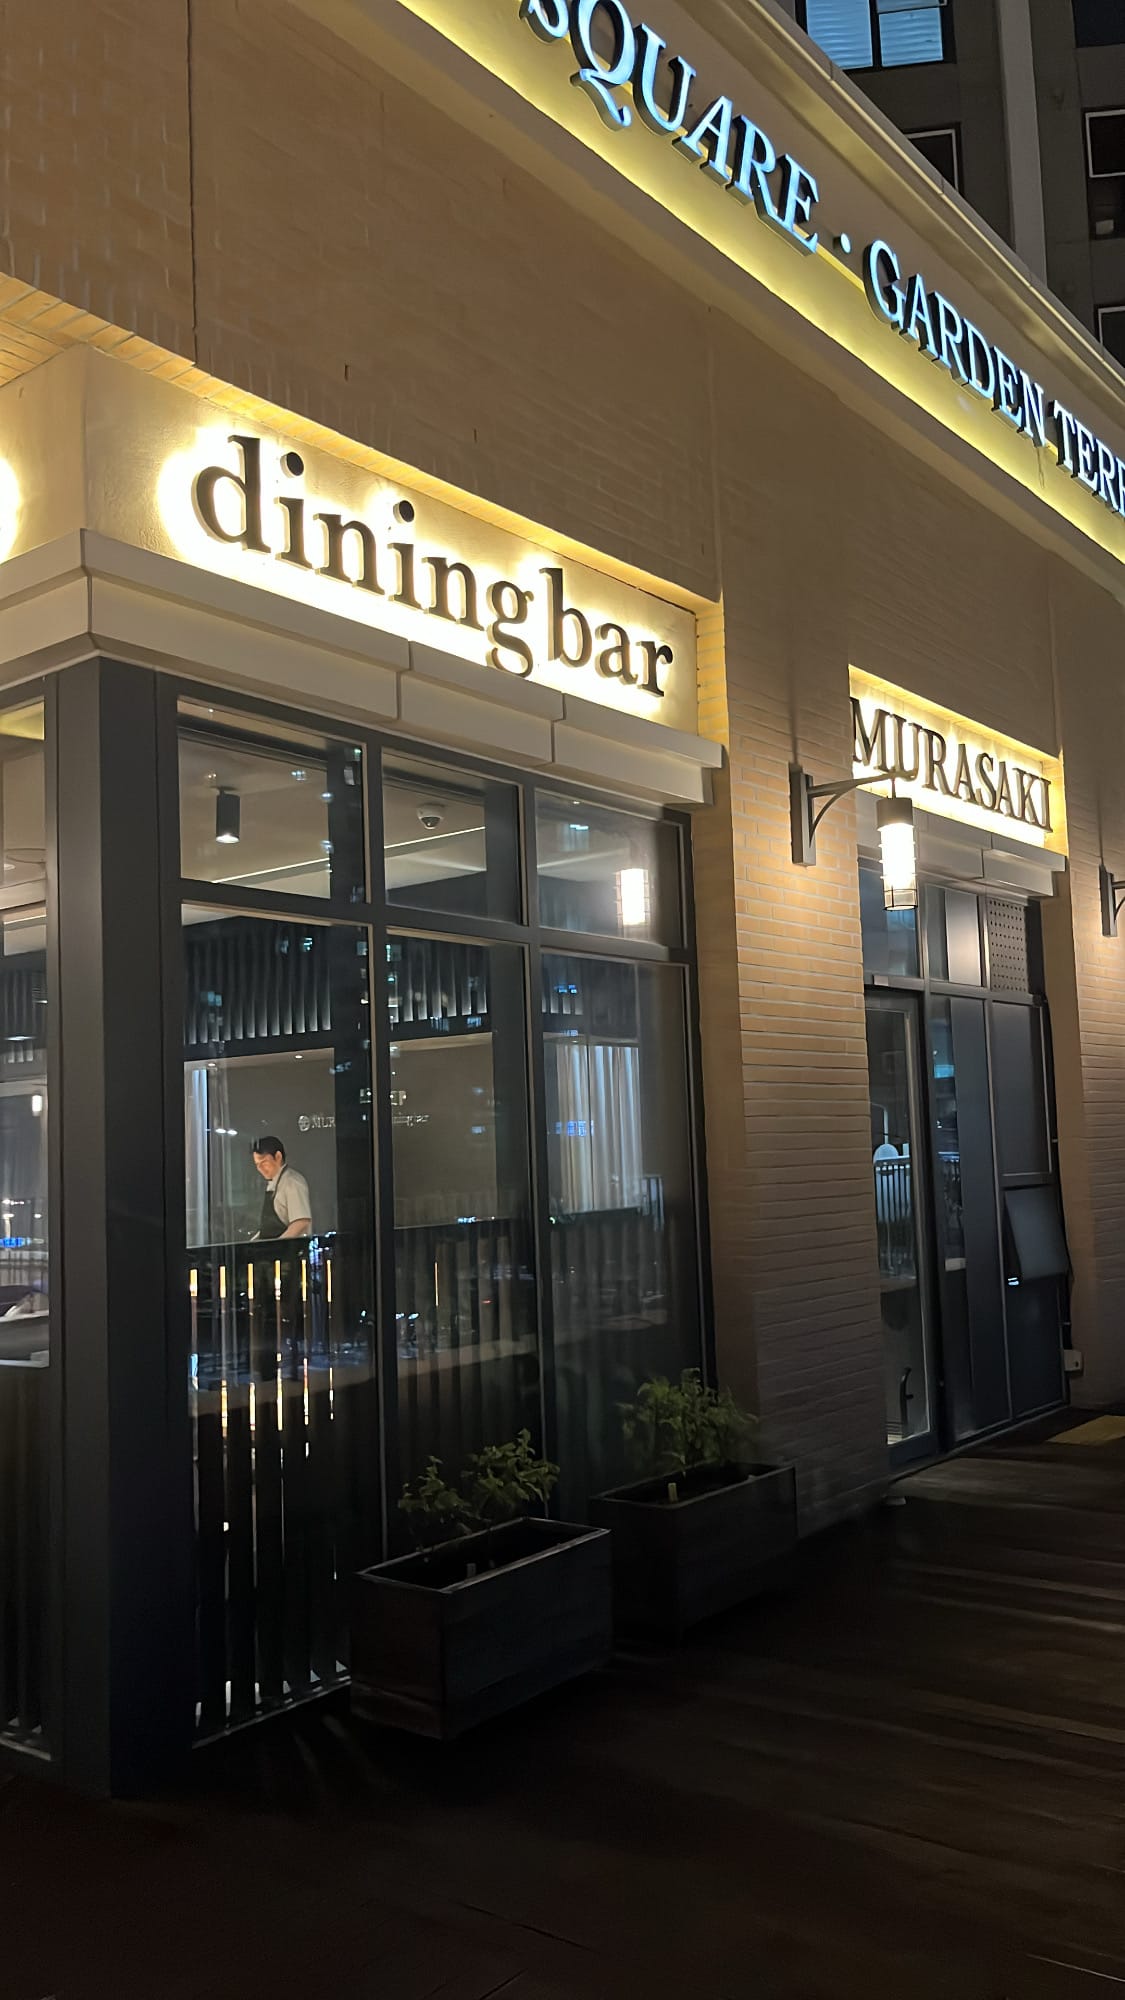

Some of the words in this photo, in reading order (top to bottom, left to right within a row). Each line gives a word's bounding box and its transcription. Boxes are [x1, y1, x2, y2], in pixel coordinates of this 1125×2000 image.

[862, 239, 1045, 448] GARDEN
[190, 434, 535, 679] dining
[540, 567, 674, 698] bar
[849, 696, 1053, 833] MURASAKI
